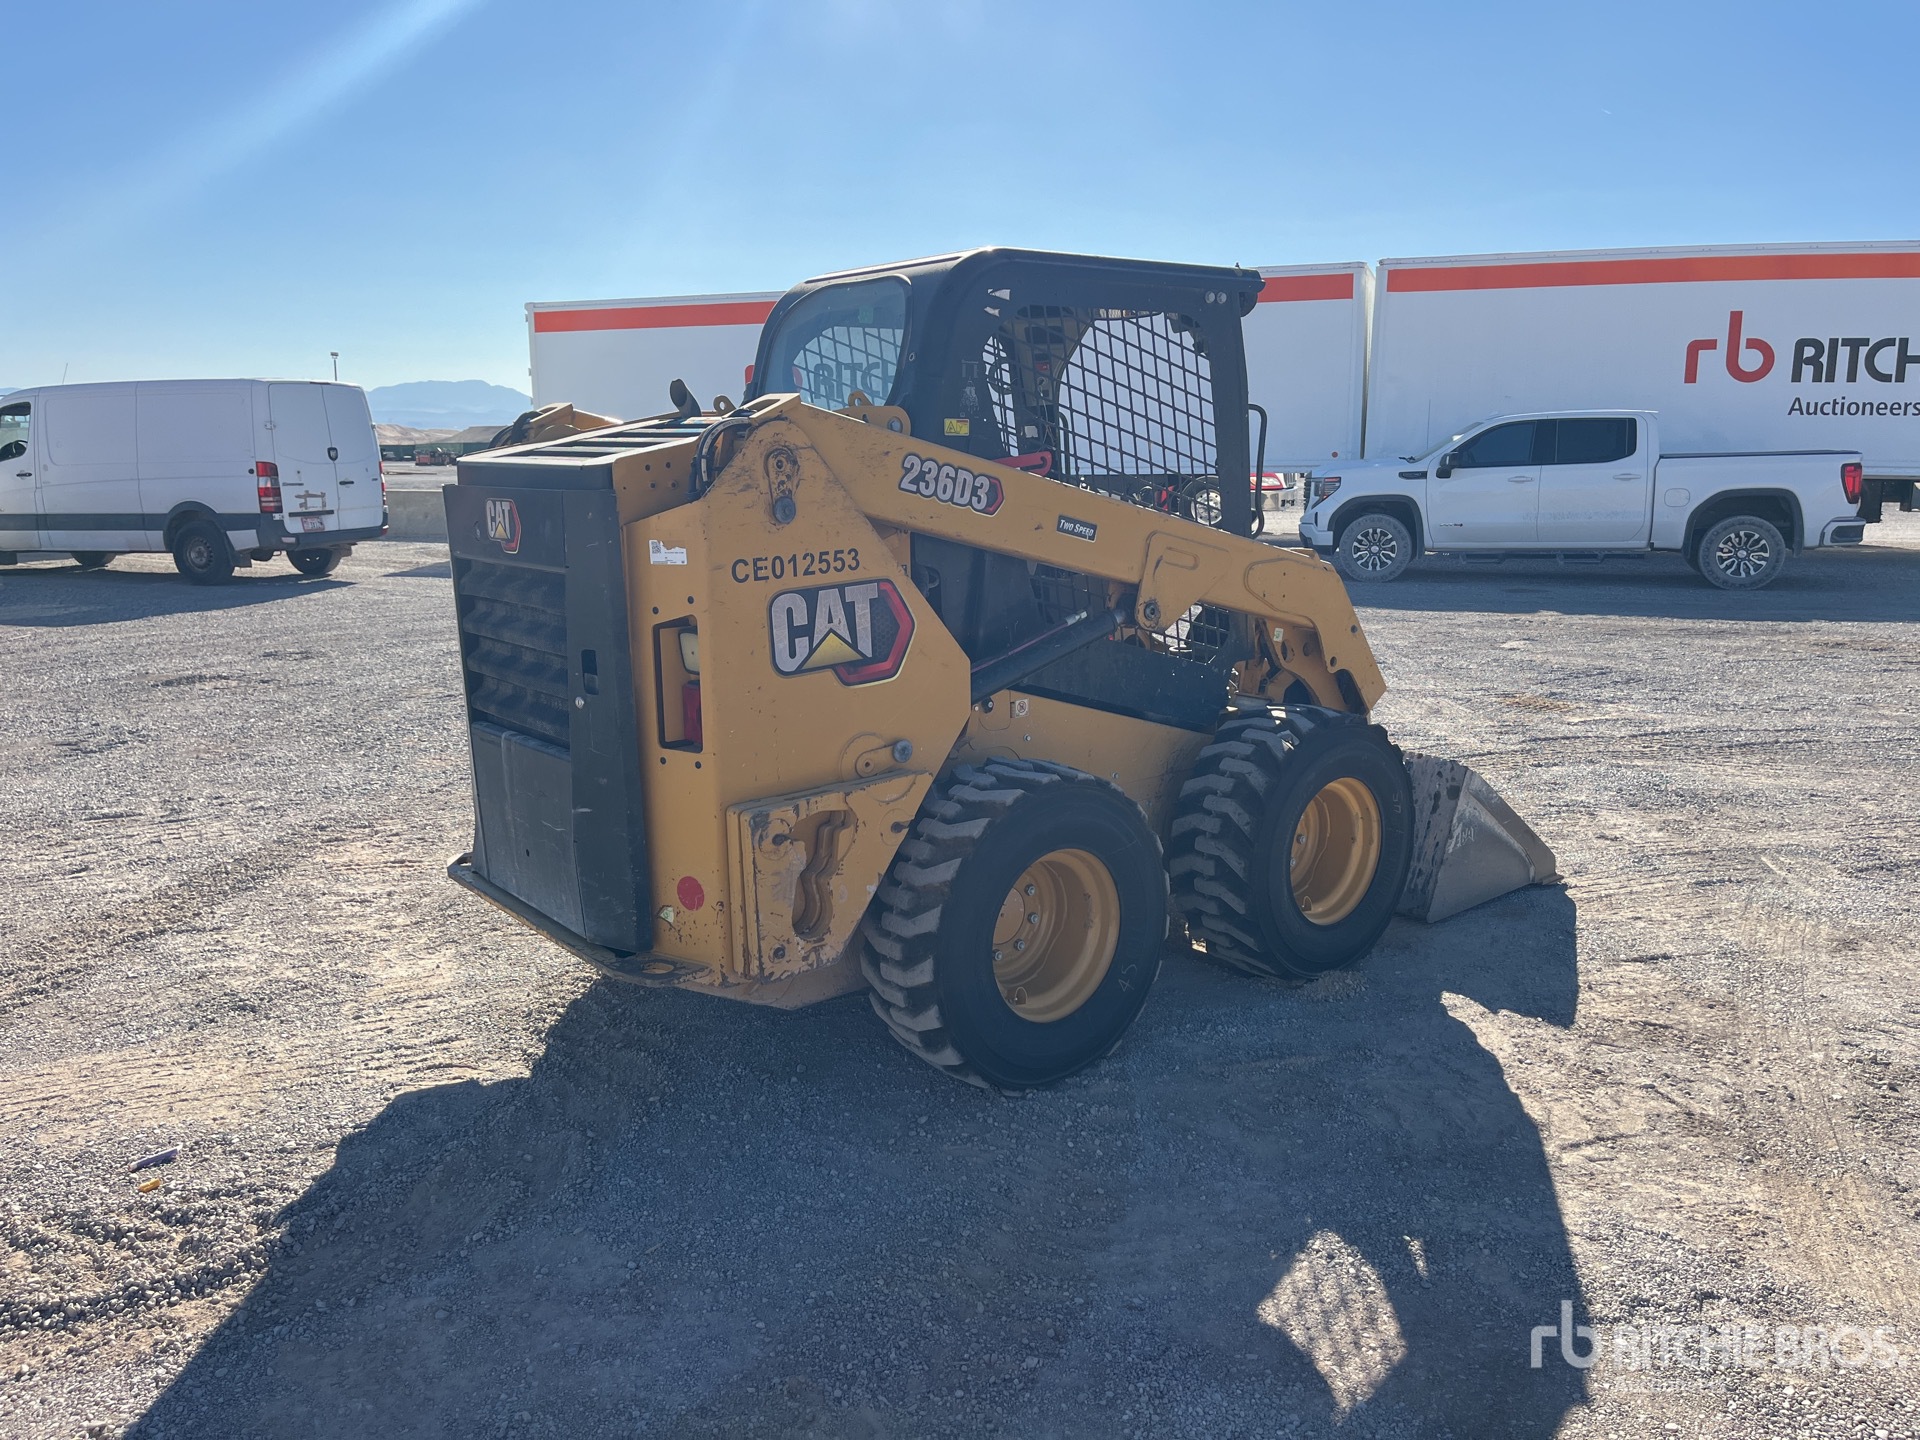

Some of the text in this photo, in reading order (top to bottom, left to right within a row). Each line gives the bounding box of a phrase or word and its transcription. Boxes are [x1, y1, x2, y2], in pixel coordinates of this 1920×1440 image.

[1684, 310, 1775, 383] rb
[900, 455, 990, 510] 236D3
[486, 500, 511, 539] CAT
[731, 548, 860, 583] CE012553
[771, 582, 879, 672] CAT
